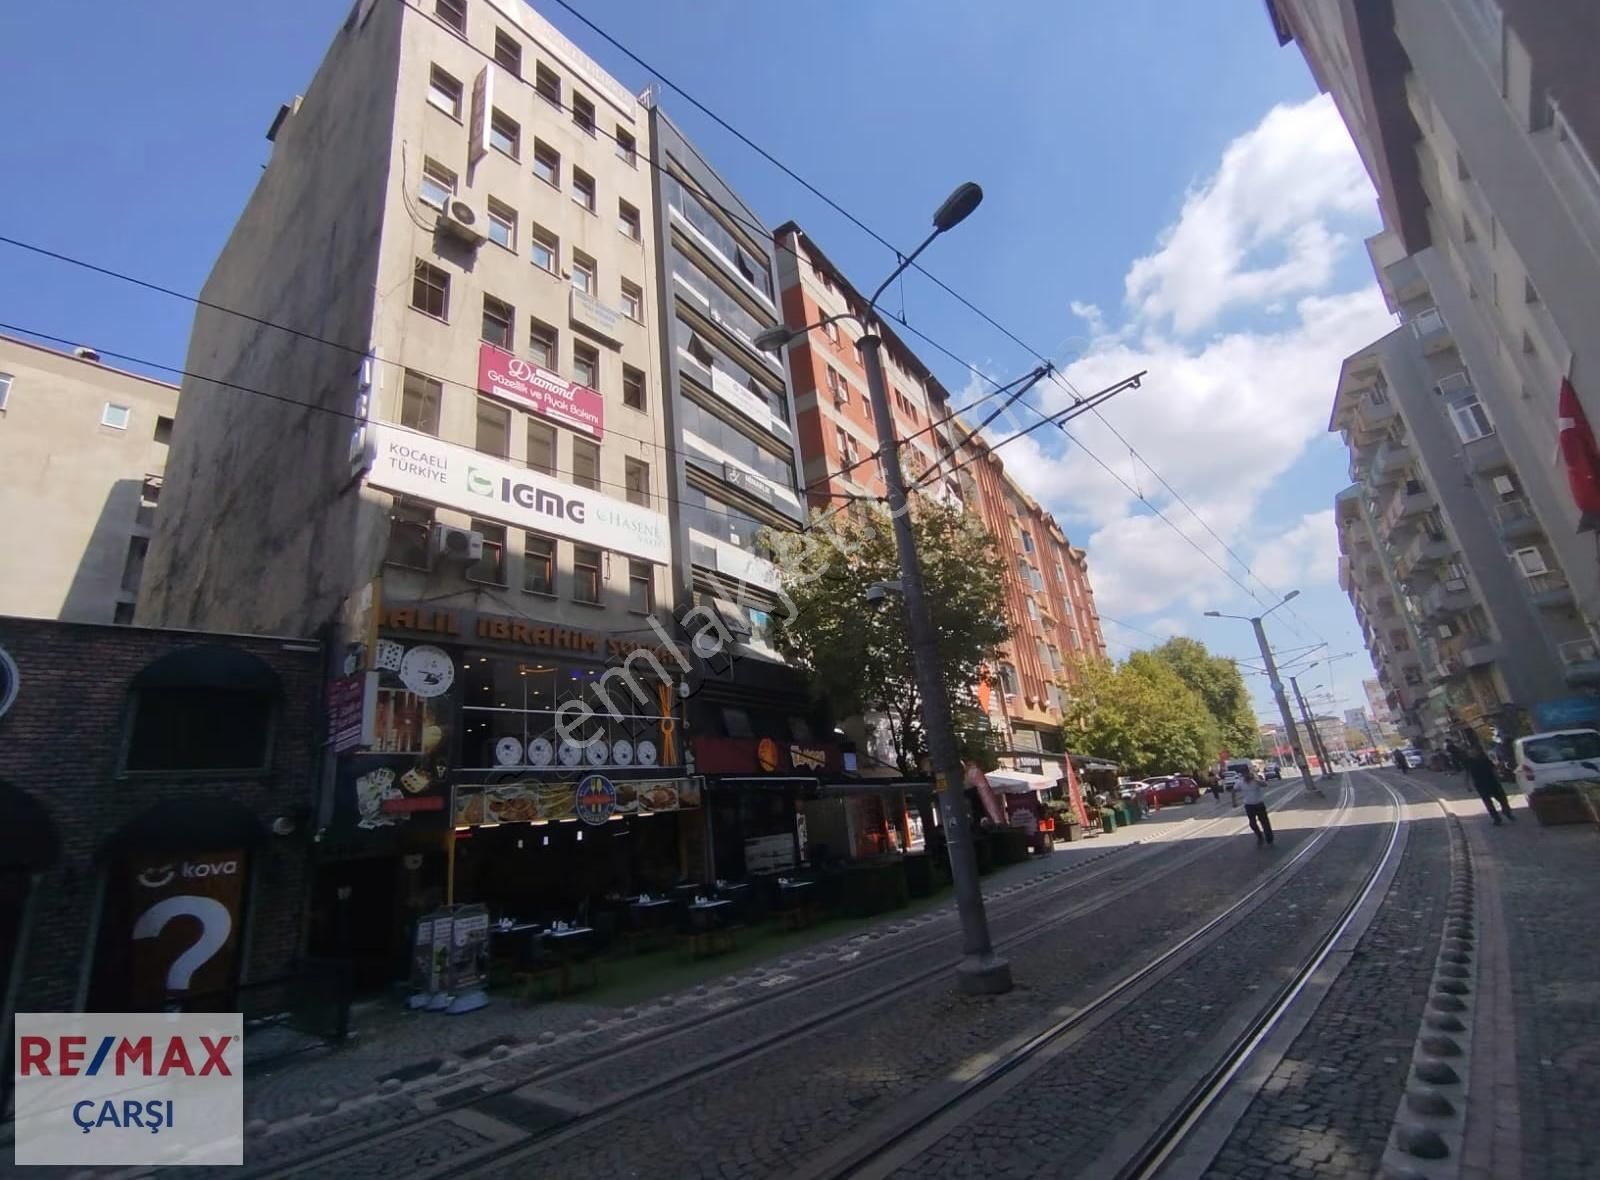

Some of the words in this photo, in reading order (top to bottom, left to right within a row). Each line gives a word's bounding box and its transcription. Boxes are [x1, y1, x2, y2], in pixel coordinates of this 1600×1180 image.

[508, 359, 581, 400] Diamond
[530, 389, 542, 400] ve
[544, 393, 568, 411] Ayak
[389, 441, 448, 470] KOCAELİ
[389, 456, 447, 484] TÜRKİYE
[501, 477, 585, 525] IGMG
[183, 861, 237, 878] kova
